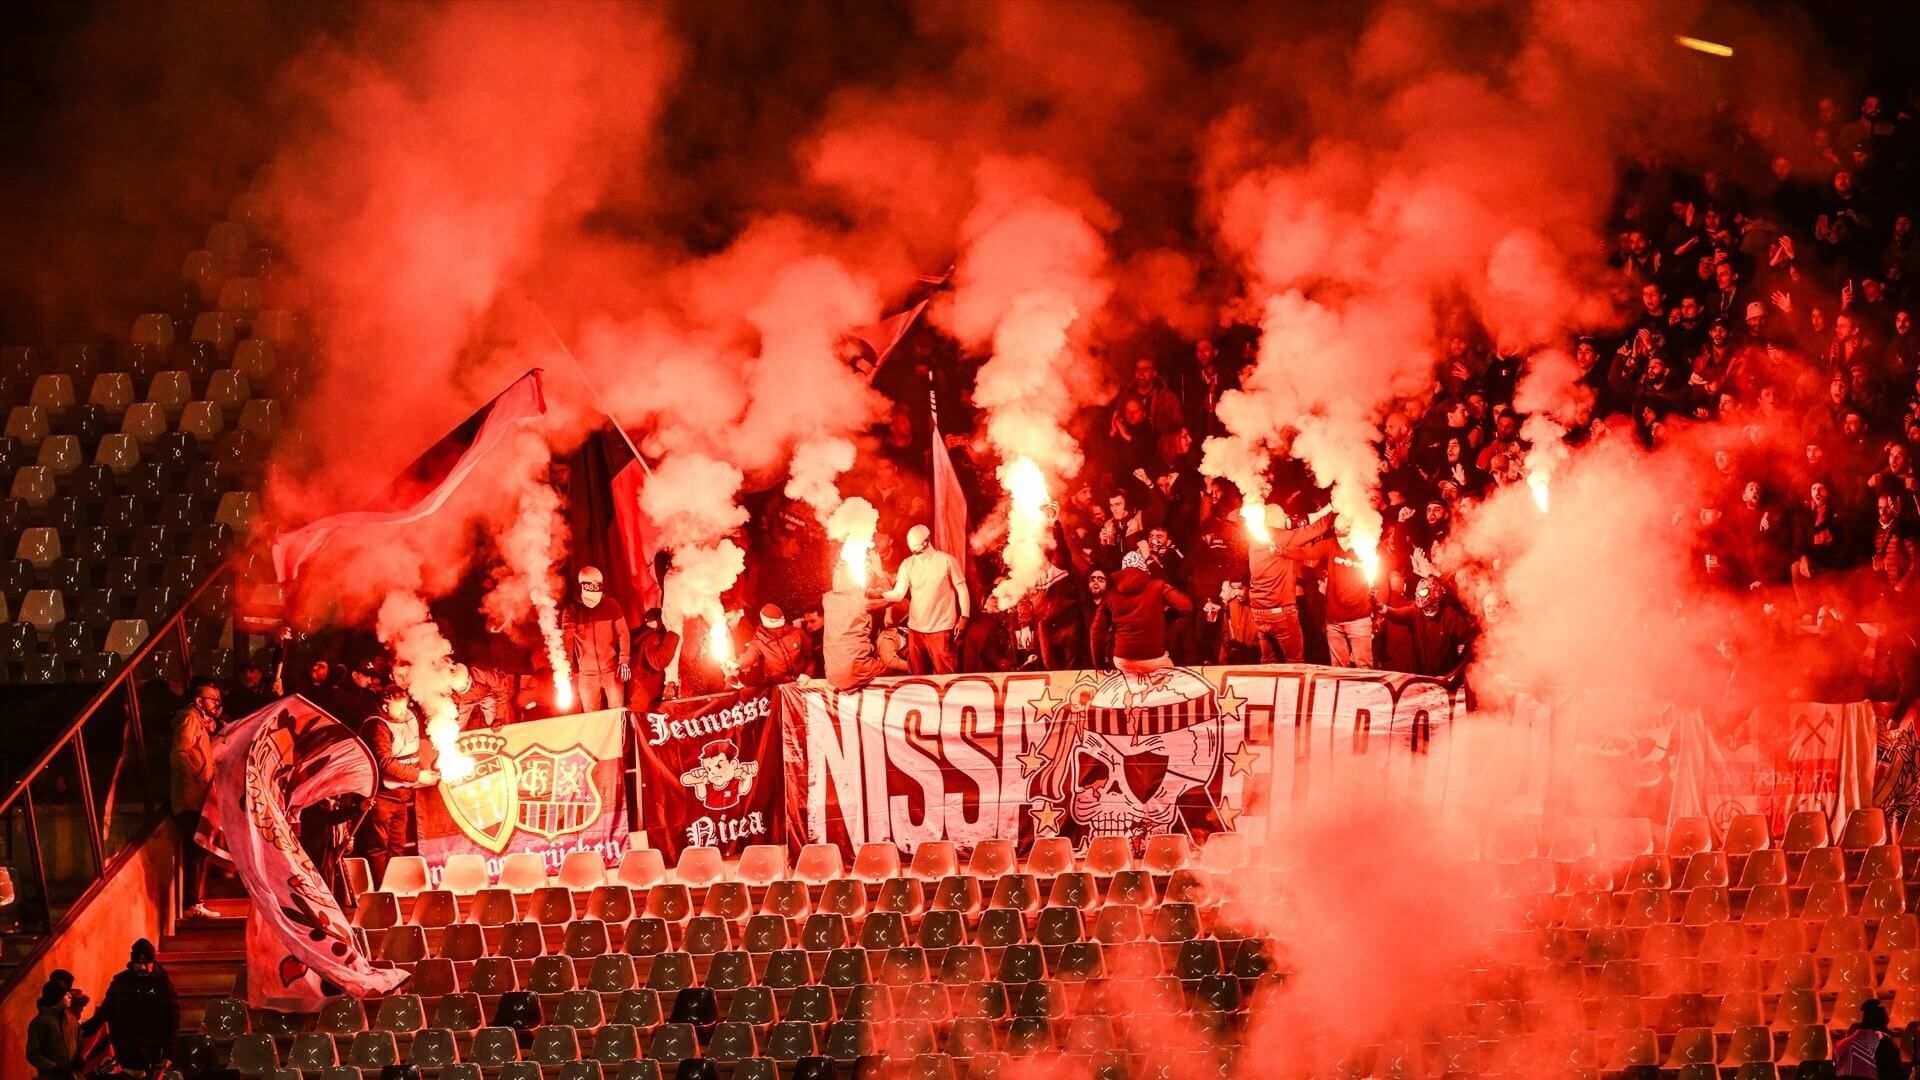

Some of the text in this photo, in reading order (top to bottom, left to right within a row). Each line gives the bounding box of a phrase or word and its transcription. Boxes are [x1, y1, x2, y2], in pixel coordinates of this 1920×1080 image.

[647, 696, 772, 746] Jeunesse
[806, 671, 1520, 857] NISSA EURO
[686, 810, 767, 848] Nicea
